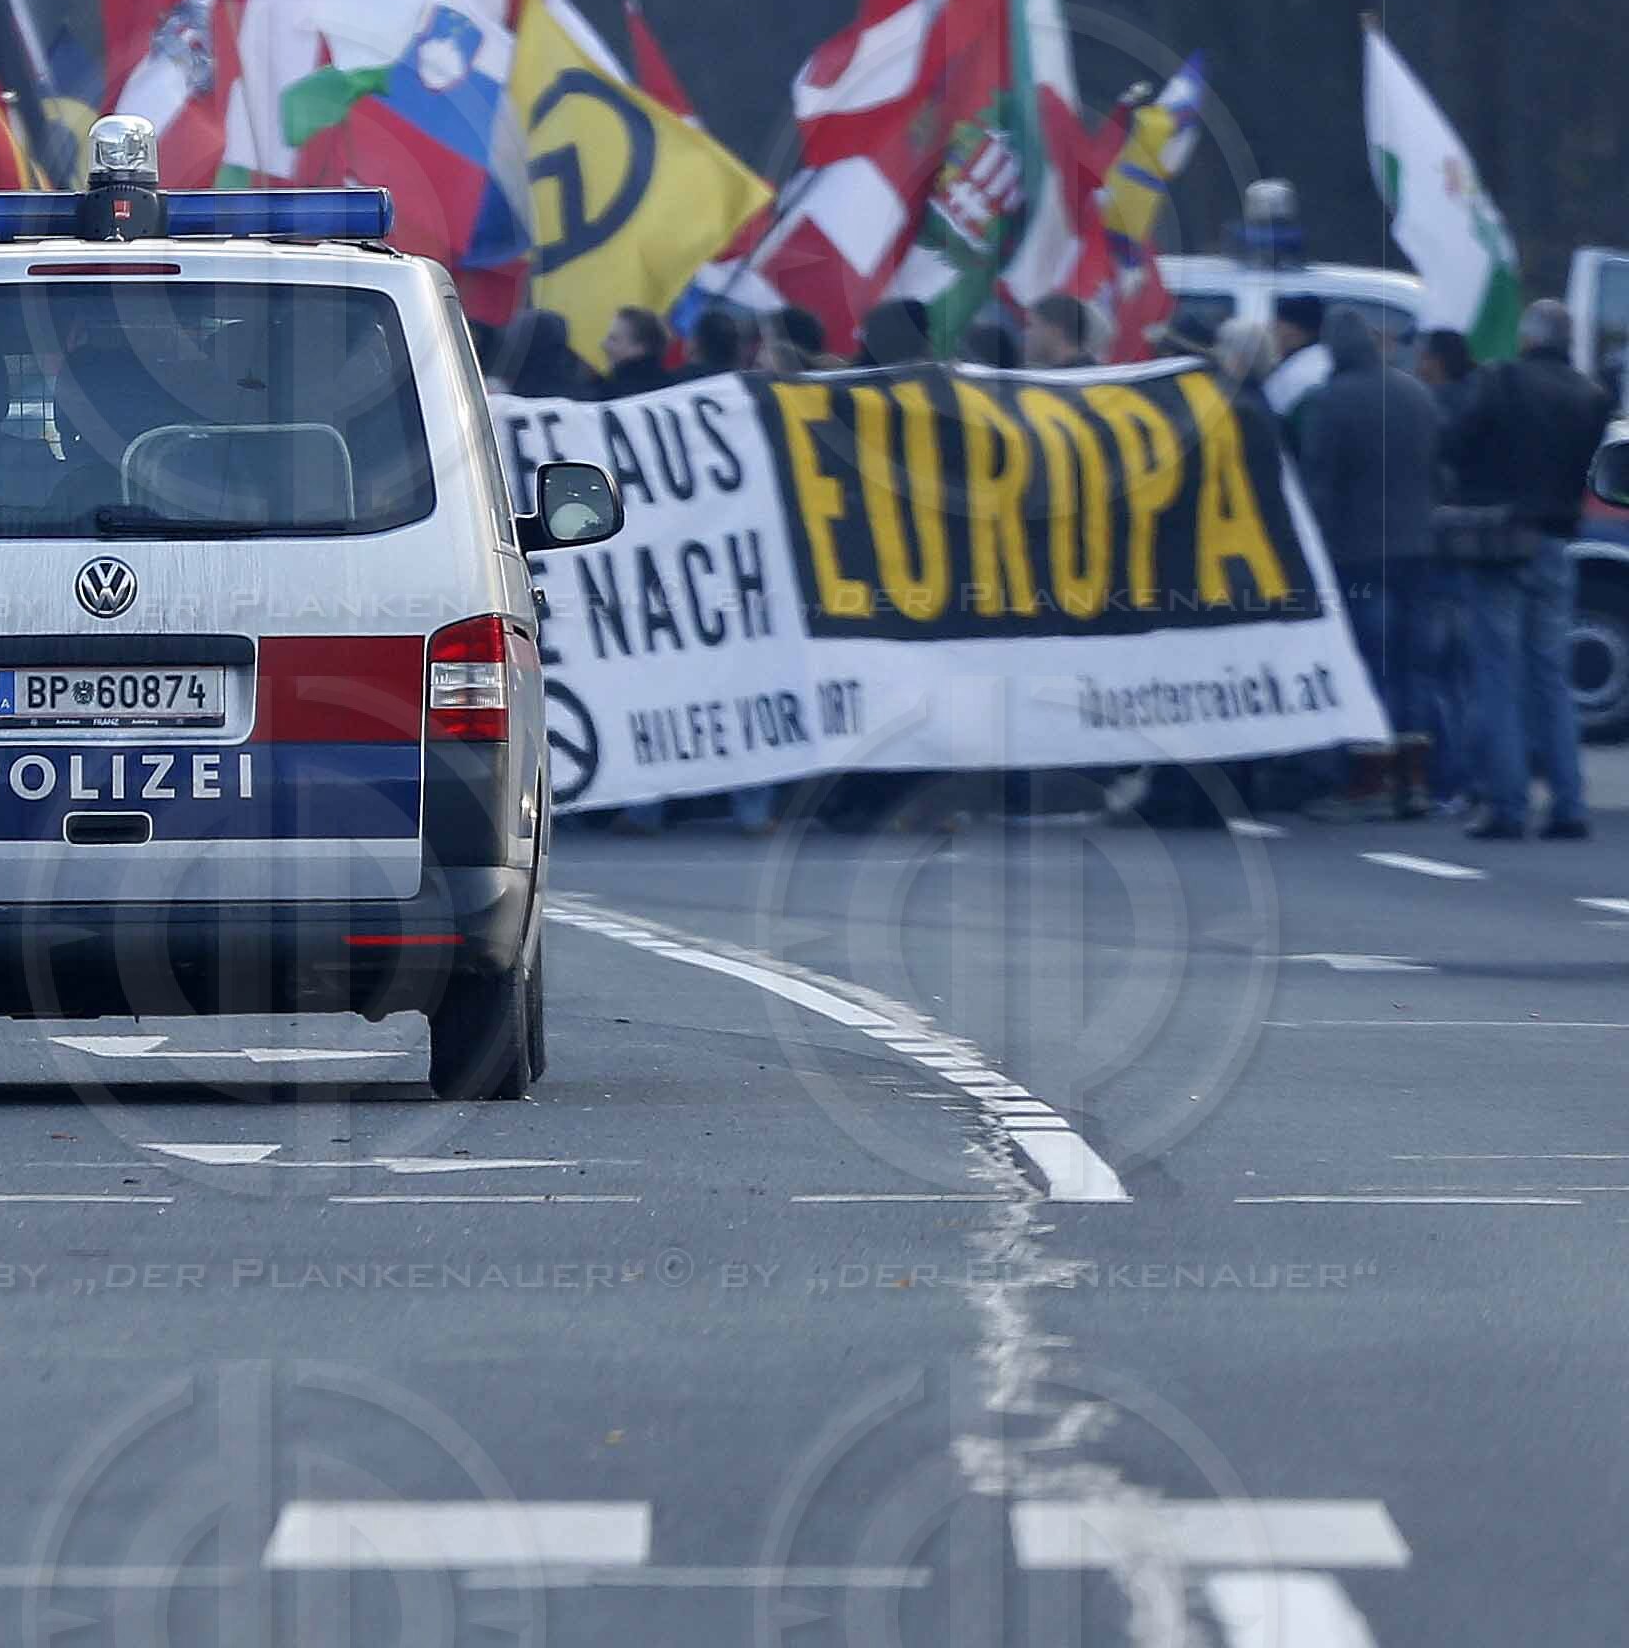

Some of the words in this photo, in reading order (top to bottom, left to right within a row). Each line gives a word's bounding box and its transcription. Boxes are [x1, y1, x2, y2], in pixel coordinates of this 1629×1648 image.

[601, 397, 742, 503] AUS
[769, 370, 1288, 620] EUROPA
[574, 529, 771, 659] NACH
[27, 675, 69, 709] BP
[97, 674, 206, 709] 60874
[628, 699, 729, 765] HILFE
[734, 689, 810, 752] VOR
